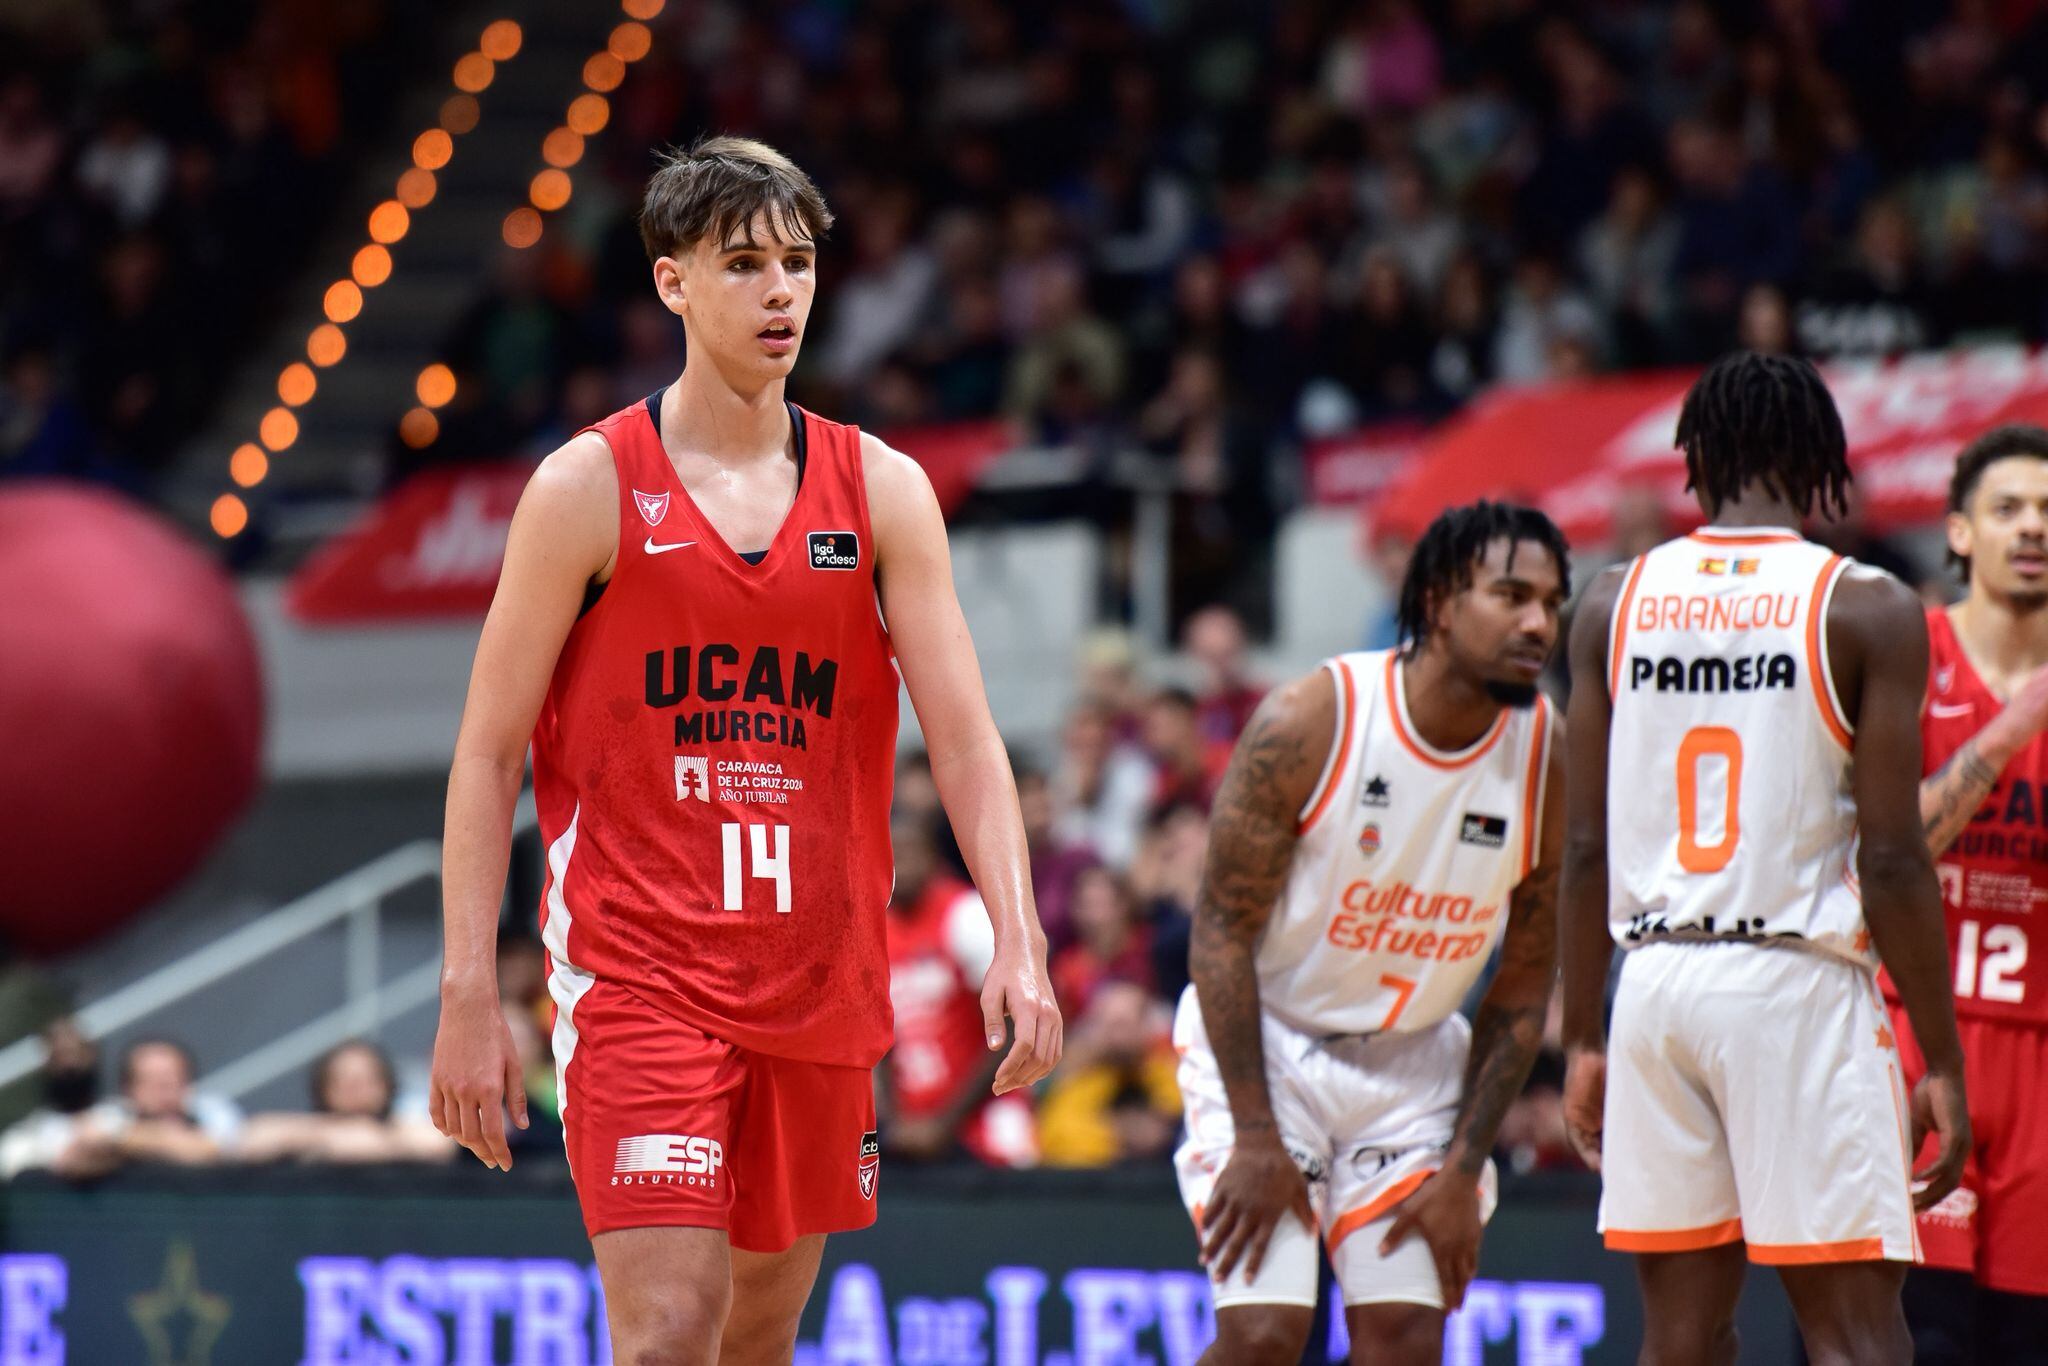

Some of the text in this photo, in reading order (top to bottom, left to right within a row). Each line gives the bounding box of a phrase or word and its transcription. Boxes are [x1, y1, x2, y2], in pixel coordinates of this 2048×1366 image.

[814, 543, 834, 556] liga
[814, 553, 856, 565] endesa
[1636, 594, 1799, 632] BRANCOU
[645, 643, 839, 719] UCAM
[1631, 653, 1796, 692] PAMESA
[674, 710, 807, 752] MURCIA
[717, 761, 783, 775] CARAVACA
[718, 776, 803, 791] DE LA CRUZ 2024
[719, 788, 788, 805] AÑO JUBILAR
[1676, 725, 1744, 874] 0
[721, 822, 792, 913] 14
[1342, 880, 1474, 923] Cultura
[1327, 914, 1487, 961] Esfuerzo
[1953, 919, 2029, 1004] 12
[1378, 971, 1418, 1032] 7
[647, 1134, 723, 1176] ESP
[611, 1174, 716, 1188] SOLUTIONS
